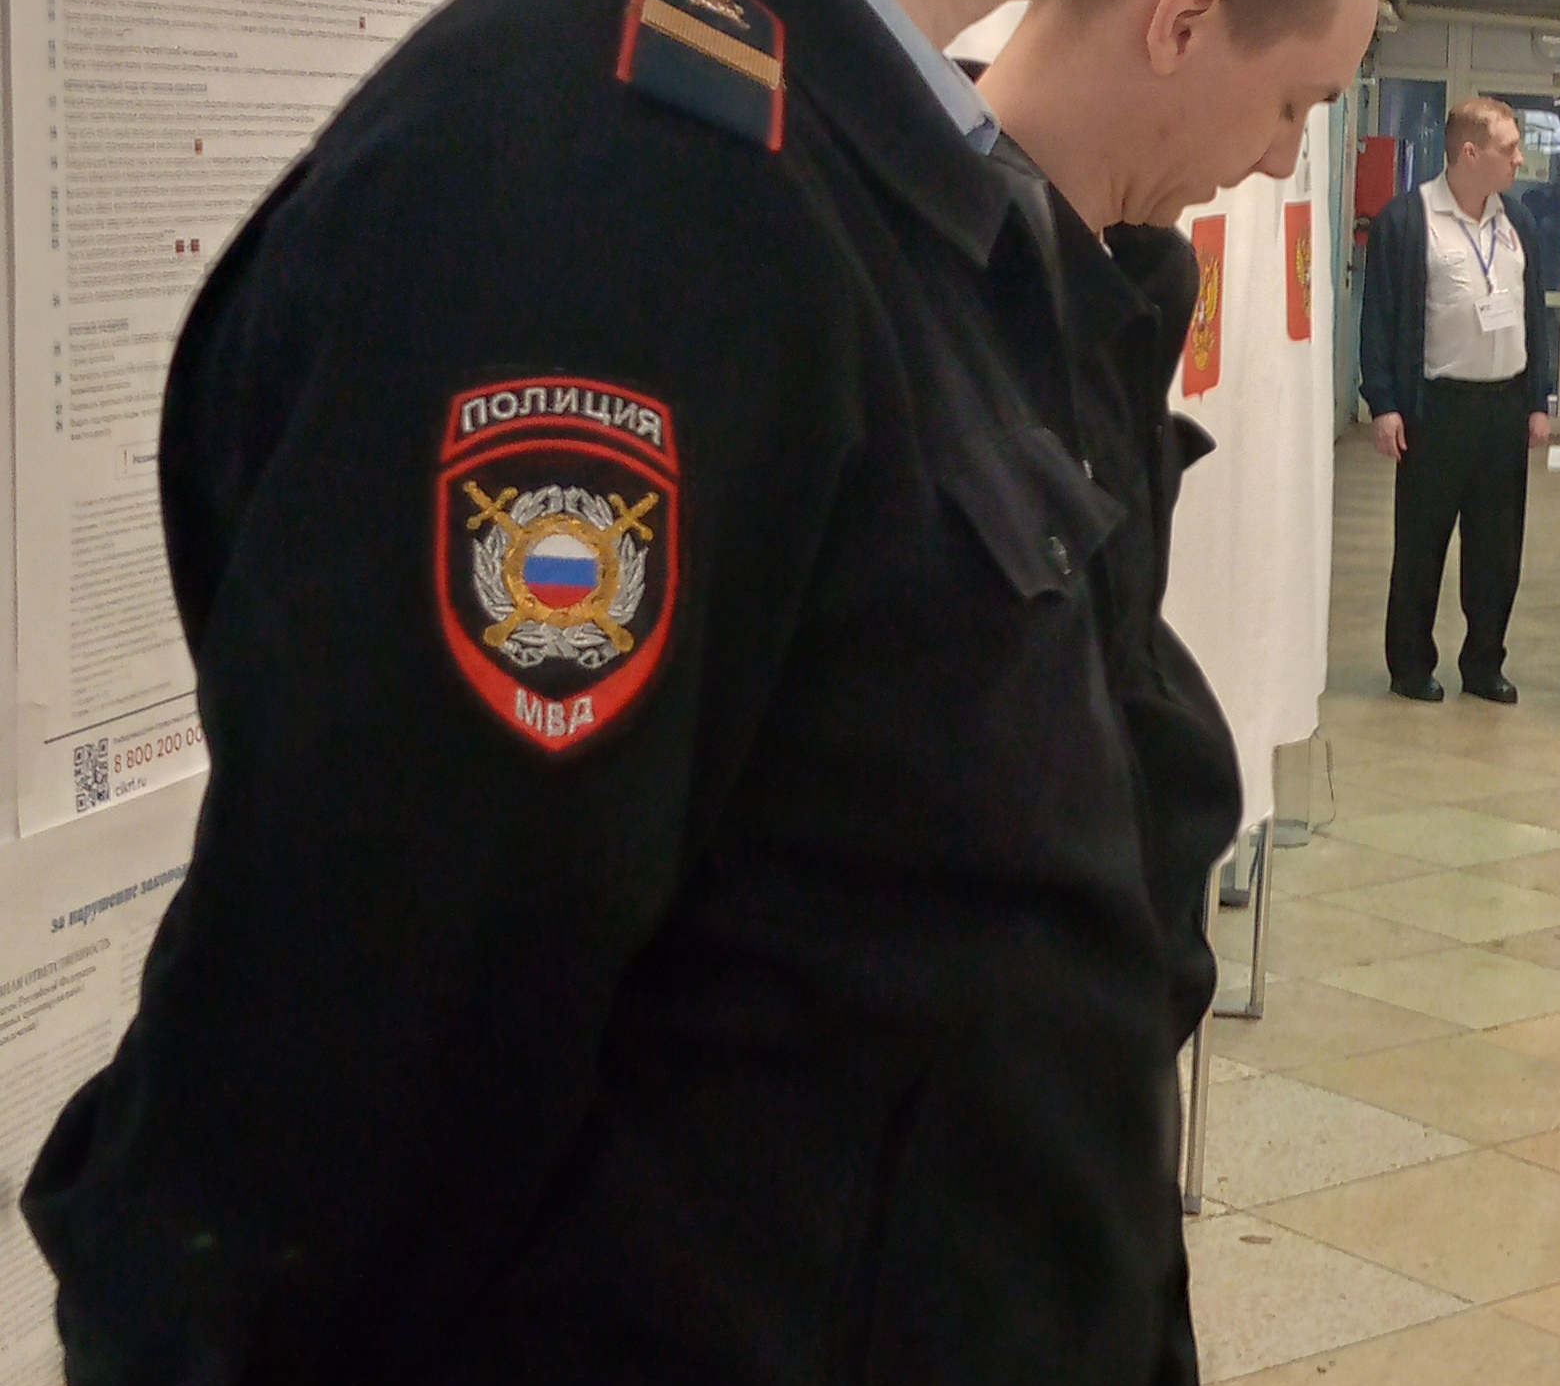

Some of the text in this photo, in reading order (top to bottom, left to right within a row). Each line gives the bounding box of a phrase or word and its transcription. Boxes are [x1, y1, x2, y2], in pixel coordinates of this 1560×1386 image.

[461, 386, 663, 446] ПОЛИЦИЯ
[516, 687, 596, 738] МВД
[114, 752, 123, 775] 8
[126, 742, 154, 770] 800
[157, 731, 183, 760] 200
